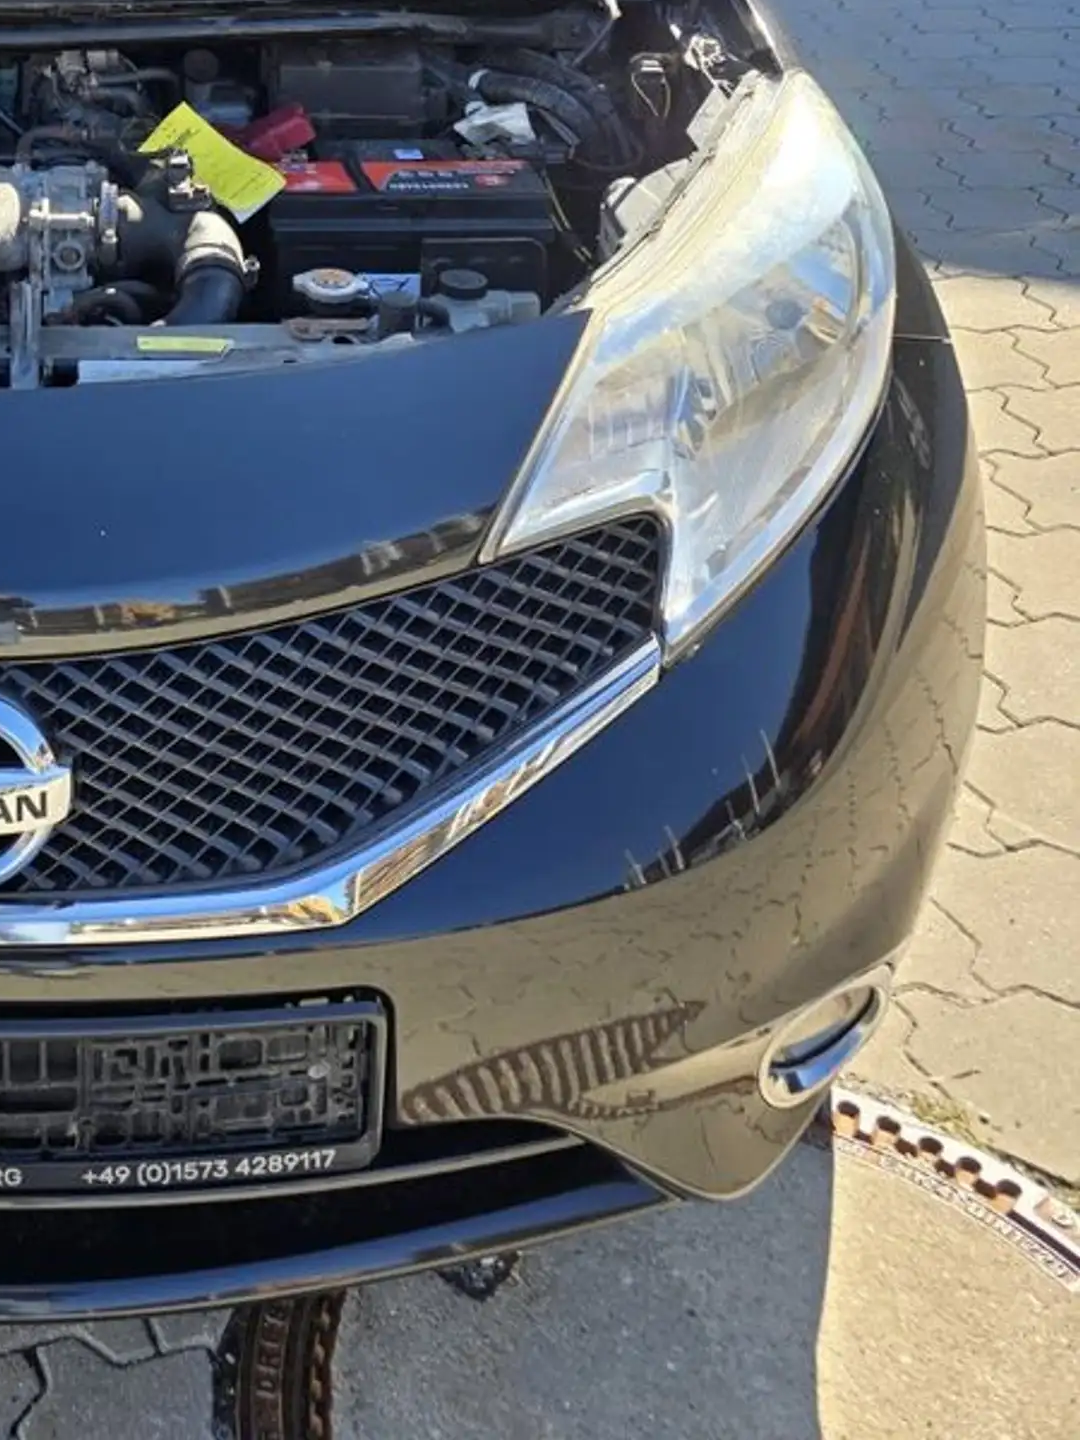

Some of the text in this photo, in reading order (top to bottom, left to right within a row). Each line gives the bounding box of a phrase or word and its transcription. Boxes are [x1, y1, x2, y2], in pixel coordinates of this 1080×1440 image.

[81, 1166, 131, 1186] +49
[136, 1160, 229, 1185] (0)1573
[234, 1149, 337, 1176] 4289117
